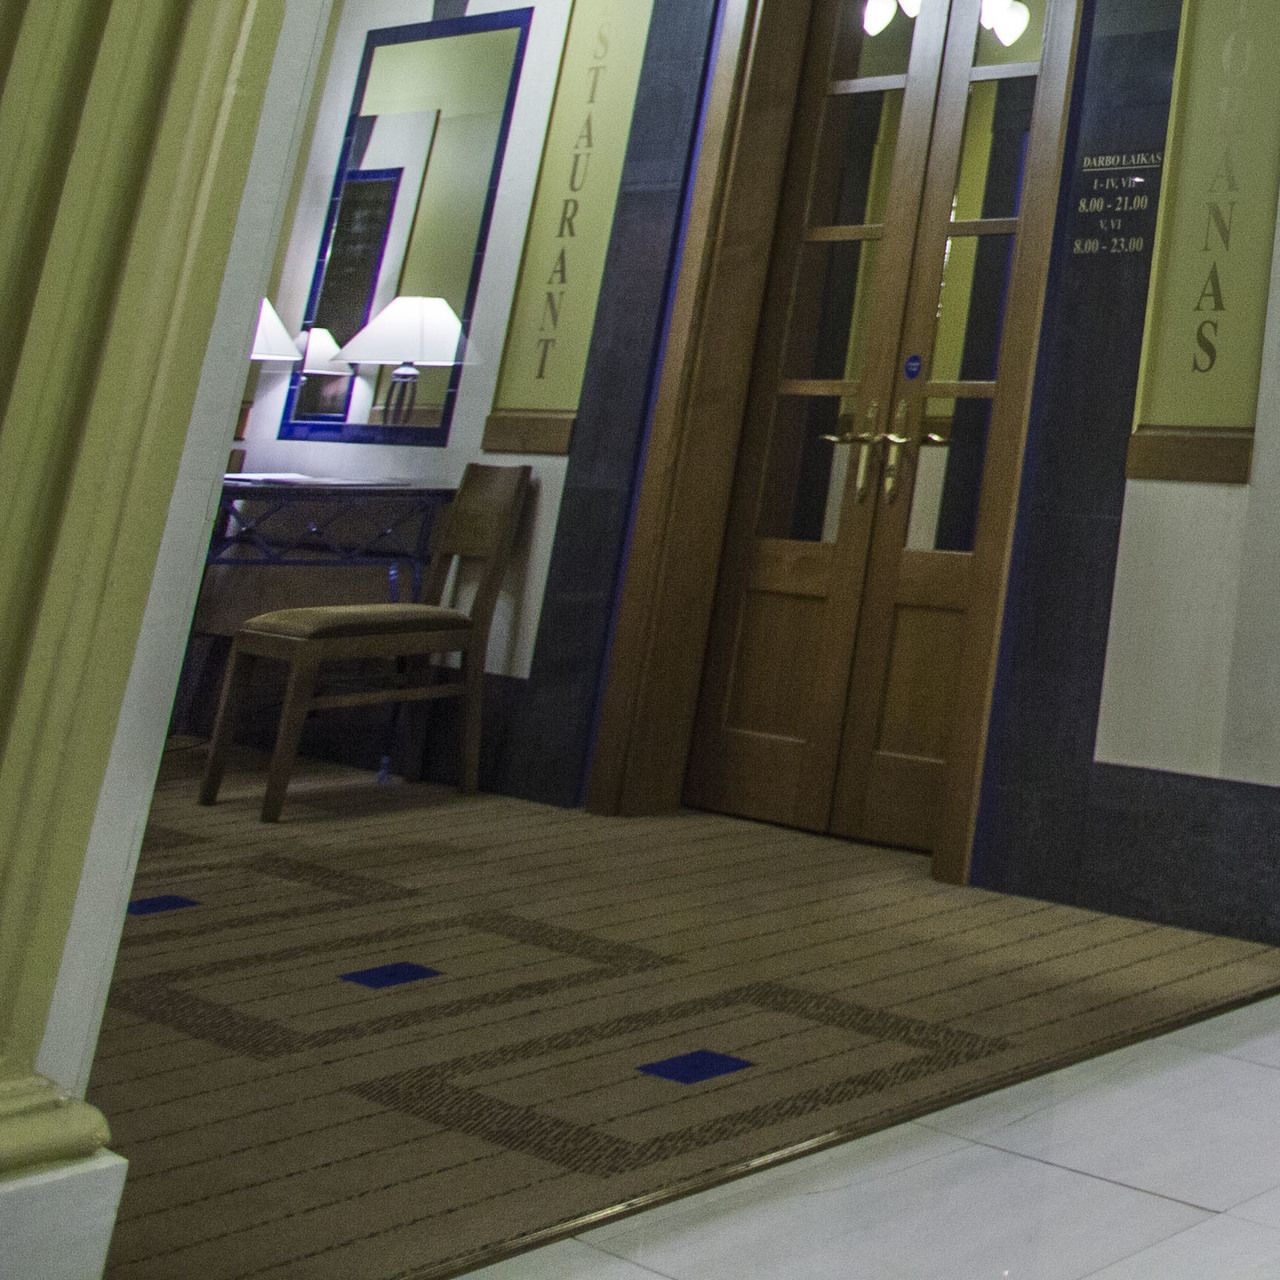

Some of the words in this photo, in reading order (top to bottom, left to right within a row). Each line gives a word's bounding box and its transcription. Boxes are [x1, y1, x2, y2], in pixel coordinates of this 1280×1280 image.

[1083, 155, 1120, 168] DARBO
[1121, 152, 1162, 166] LAIKAS
[1078, 197, 1104, 213] 8.00
[1115, 195, 1148, 211] 21.00
[1073, 238, 1099, 254] 8.00
[1110, 236, 1144, 253] 23.00
